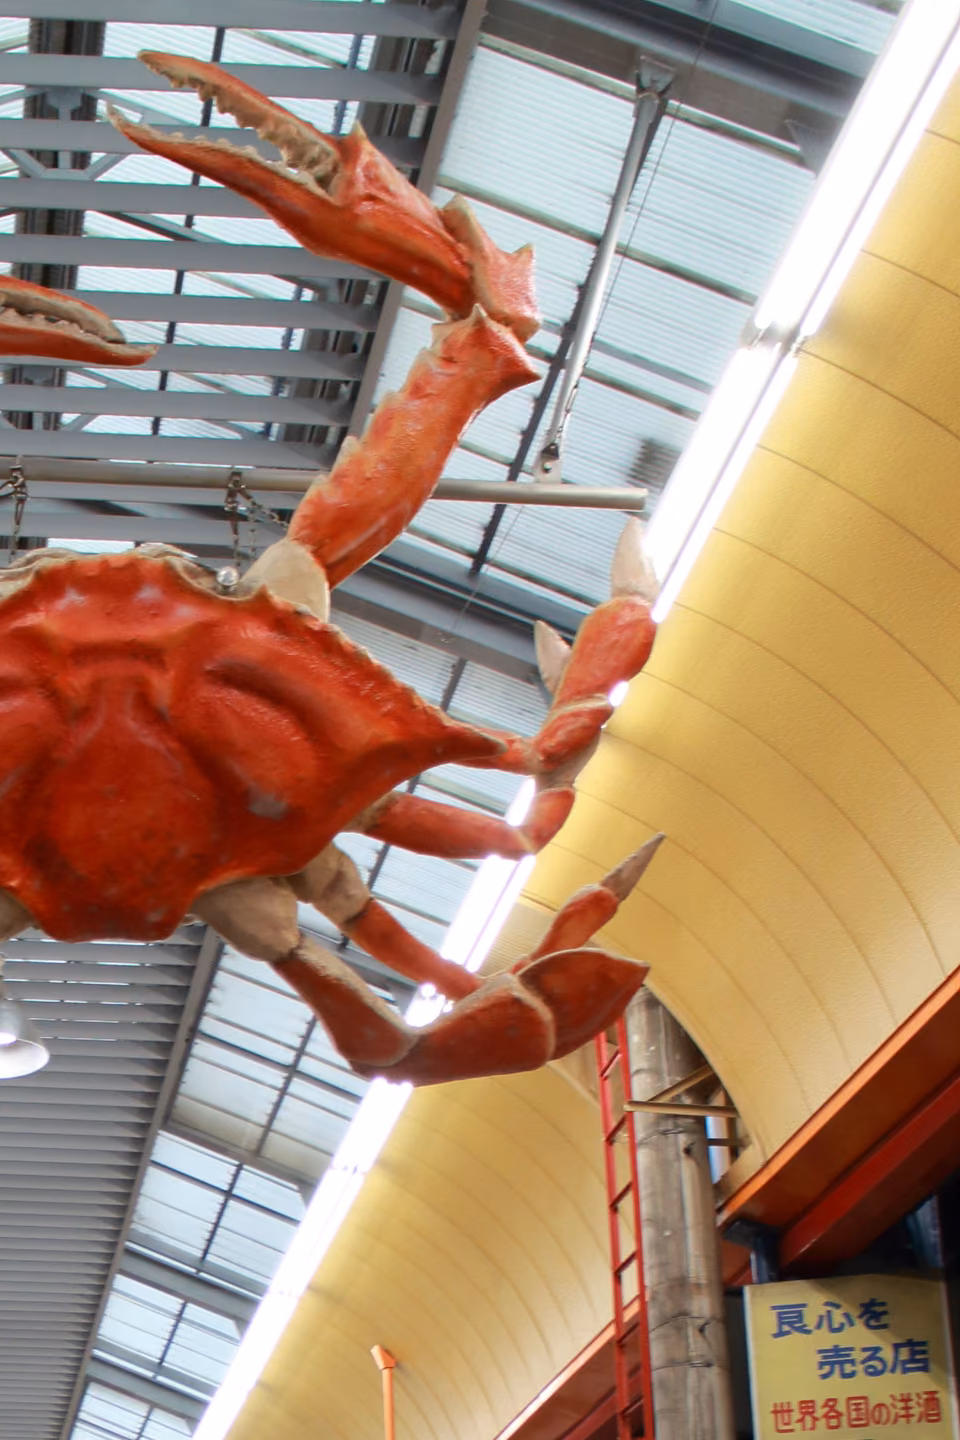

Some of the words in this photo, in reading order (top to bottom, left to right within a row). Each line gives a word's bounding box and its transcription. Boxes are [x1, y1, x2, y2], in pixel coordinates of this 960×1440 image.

[769, 1298, 890, 1339] 良心を
[816, 1339, 930, 1380] 売る店
[770, 1390, 942, 1434] 世界各国の洋酒
